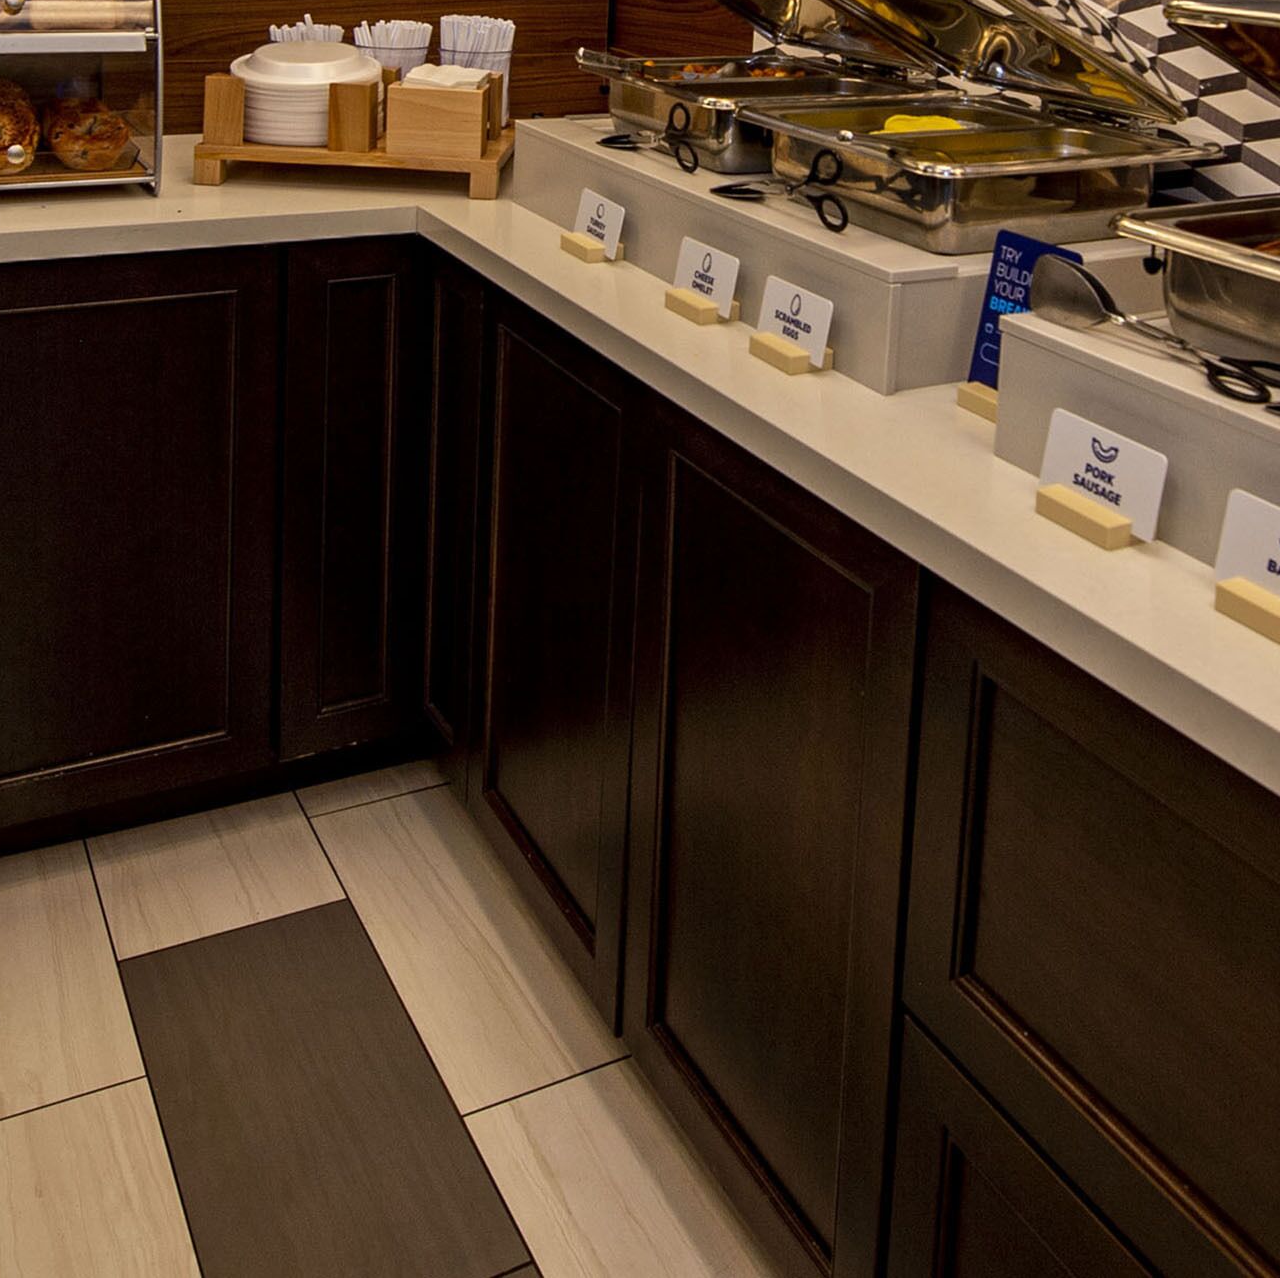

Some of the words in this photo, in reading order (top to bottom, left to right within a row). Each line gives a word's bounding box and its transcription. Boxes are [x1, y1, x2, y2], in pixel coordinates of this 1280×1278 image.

[1001, 245, 1023, 264] TRY
[691, 279, 714, 296] OMELET
[694, 269, 715, 287] CHEESE
[994, 279, 1025, 302] YOUR
[775, 309, 812, 335] SCRAMBLED
[782, 325, 799, 341] EGGS
[1084, 462, 1115, 486] PORK
[1072, 473, 1122, 506] SAUSAGE
